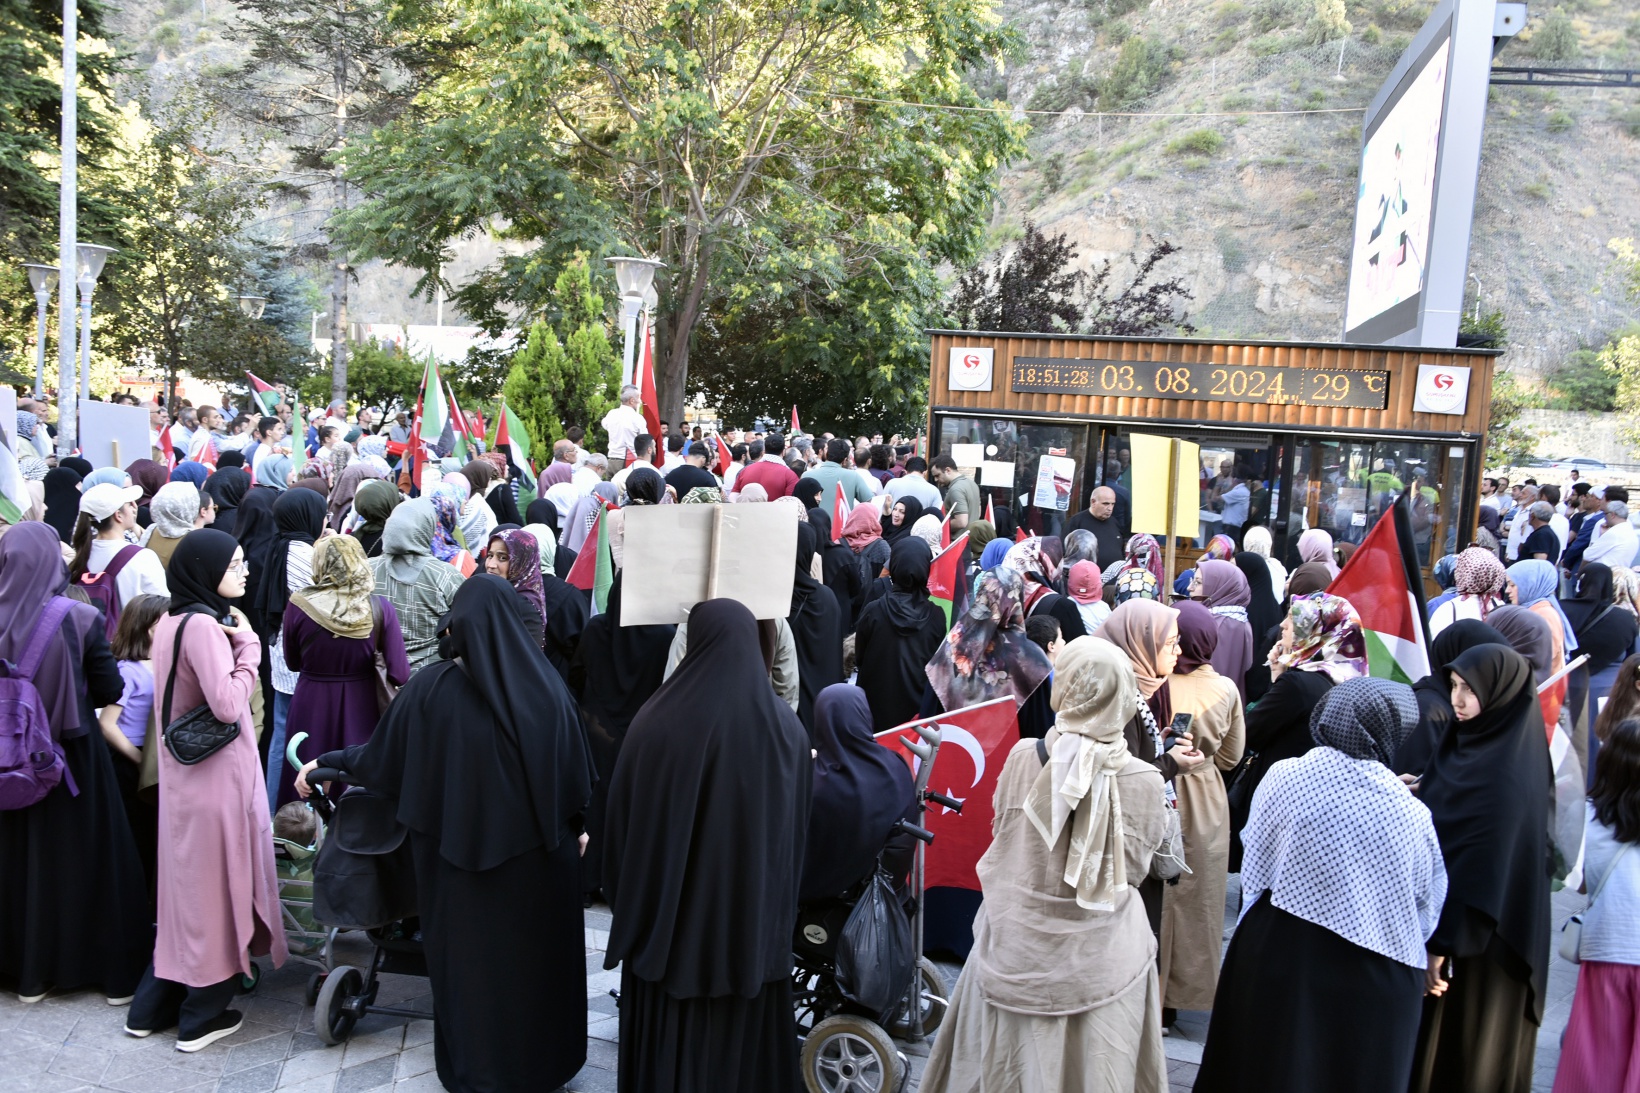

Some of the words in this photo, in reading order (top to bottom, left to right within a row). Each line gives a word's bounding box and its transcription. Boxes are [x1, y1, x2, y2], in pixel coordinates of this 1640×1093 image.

[1018, 368, 1089, 385] 18:51:28
[1209, 369, 1286, 398] 2024
[1312, 373, 1350, 401] 29
